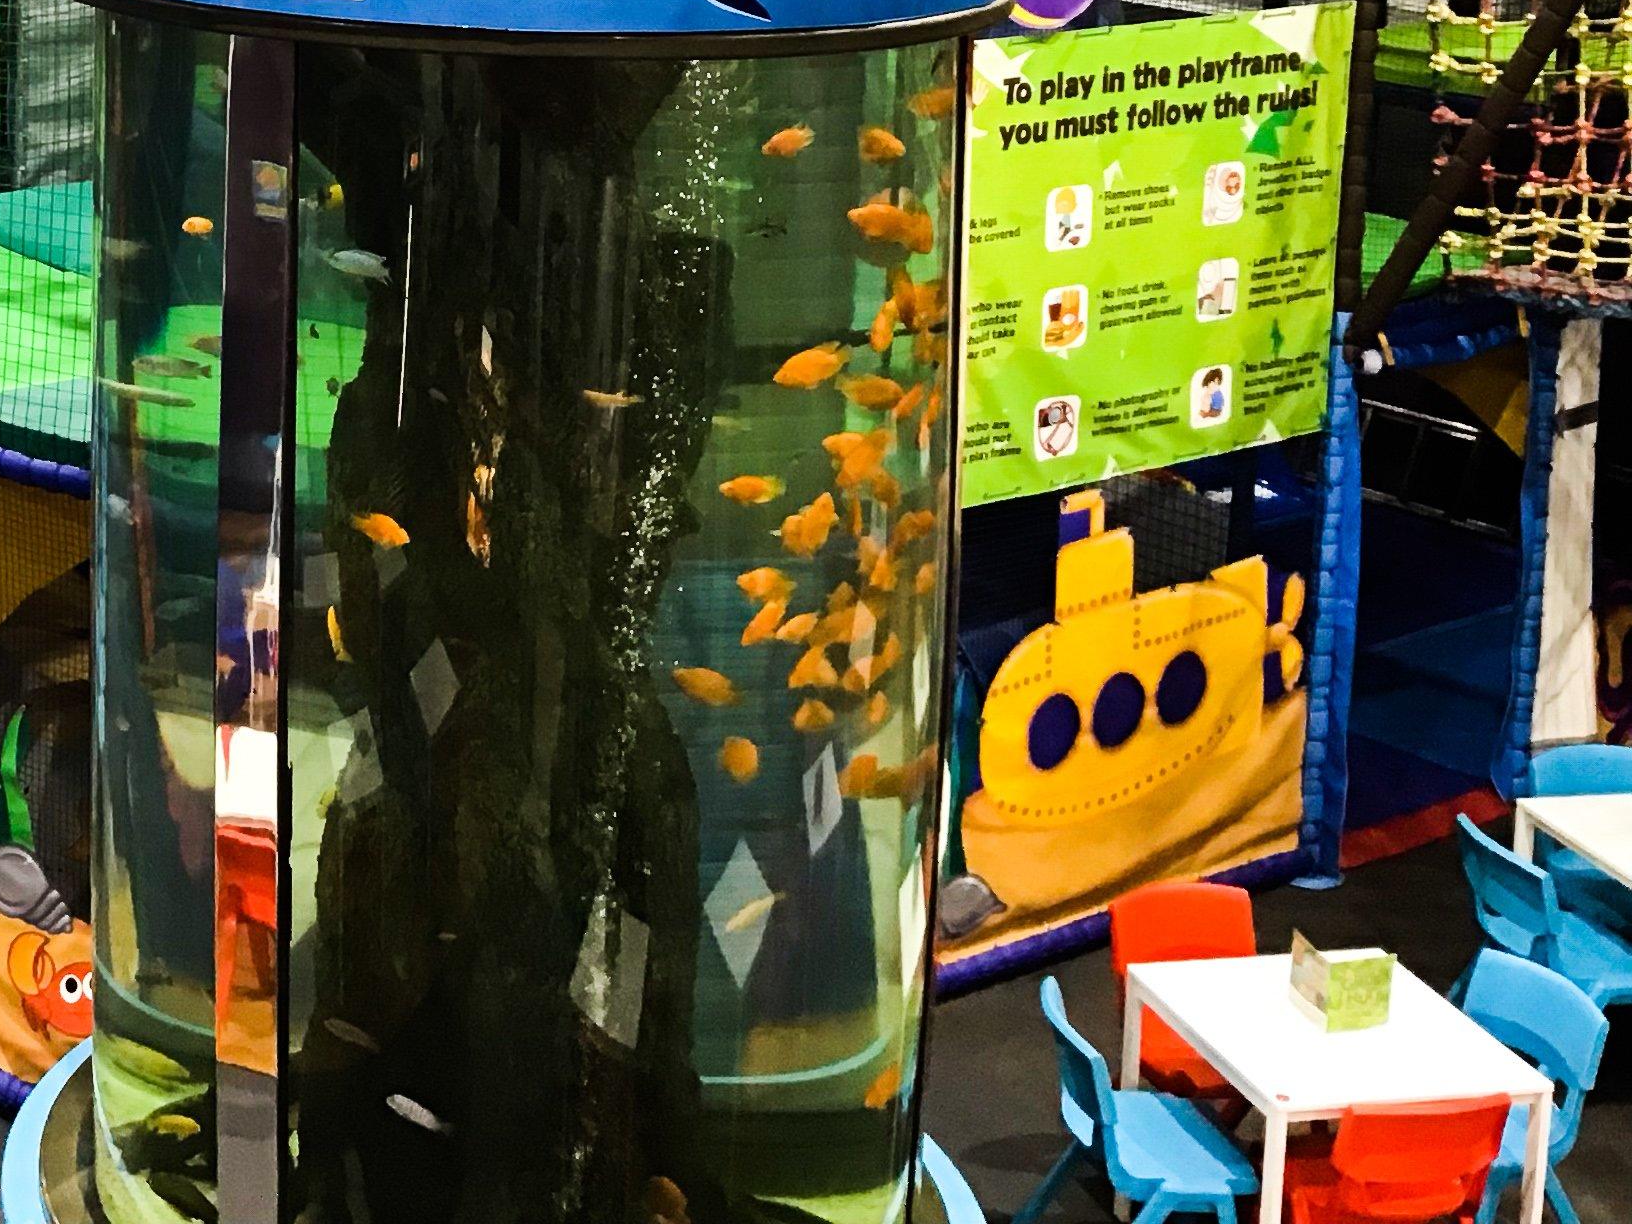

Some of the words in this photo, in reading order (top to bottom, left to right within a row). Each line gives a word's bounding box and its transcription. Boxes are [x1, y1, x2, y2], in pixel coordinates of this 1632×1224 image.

[1004, 77, 1032, 105] To
[1040, 71, 1095, 105] play
[1103, 65, 1125, 93] in
[1133, 62, 1171, 89] the
[999, 120, 1048, 150] you
[1055, 106, 1119, 140] must
[1127, 99, 1207, 131] follow
[1214, 90, 1250, 119] the
[1256, 80, 1318, 113] rules!
[969, 233, 982, 243] be
[985, 227, 1021, 242] covered
[992, 327, 1015, 339] take
